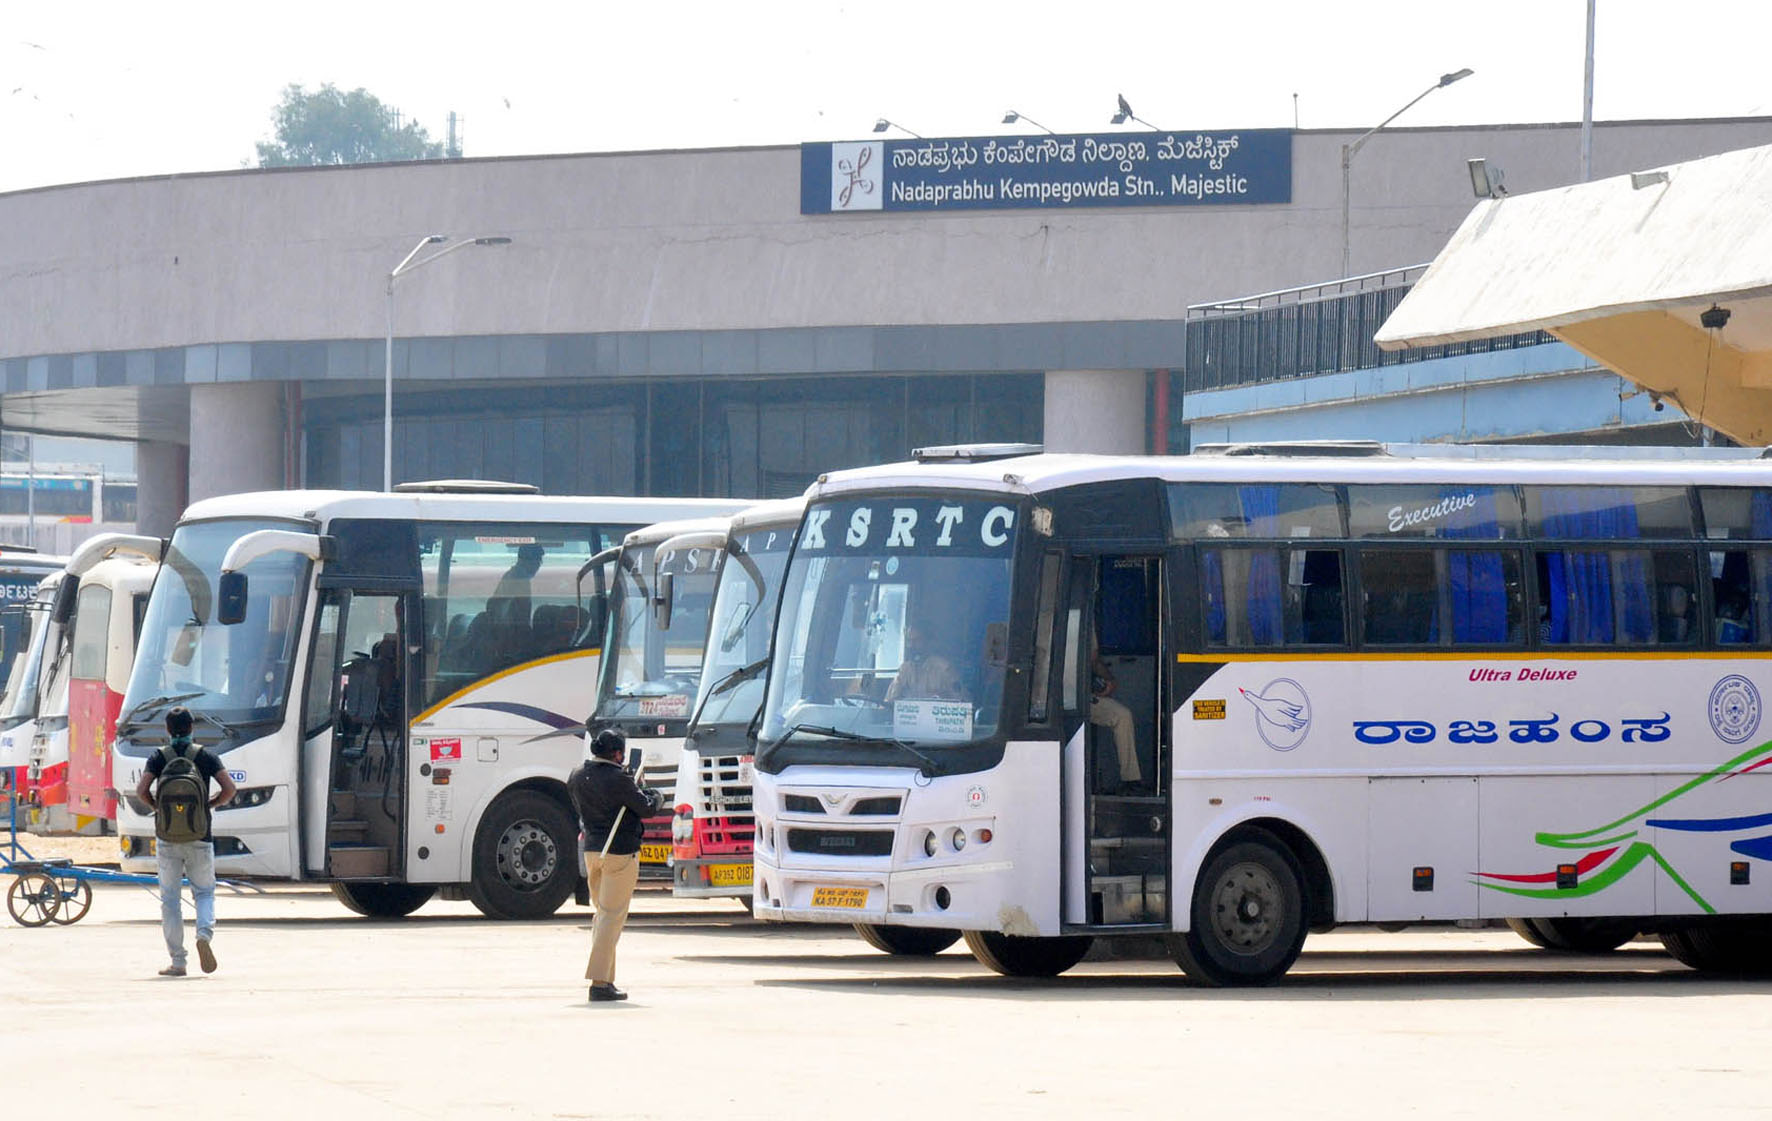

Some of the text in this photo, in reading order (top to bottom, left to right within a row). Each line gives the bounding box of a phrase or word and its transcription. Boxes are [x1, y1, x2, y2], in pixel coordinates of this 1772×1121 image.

[892, 141, 978, 173] ನಾಡಪ್ರಭು
[983, 138, 1077, 165] ಕೆಂಪೇಗೌಡ
[1157, 135, 1239, 170] ಮೆಜೆಸ್ಟಿಕ್
[891, 179, 994, 205] Nadaprabhu
[1000, 176, 1120, 203] Kempegowda
[1171, 174, 1248, 199] Majestic
[1388, 493, 1477, 533] Executive
[1468, 668, 1577, 683] Ultra Deluxe
[1353, 711, 1671, 745] ರಾಜಹಂಸ
